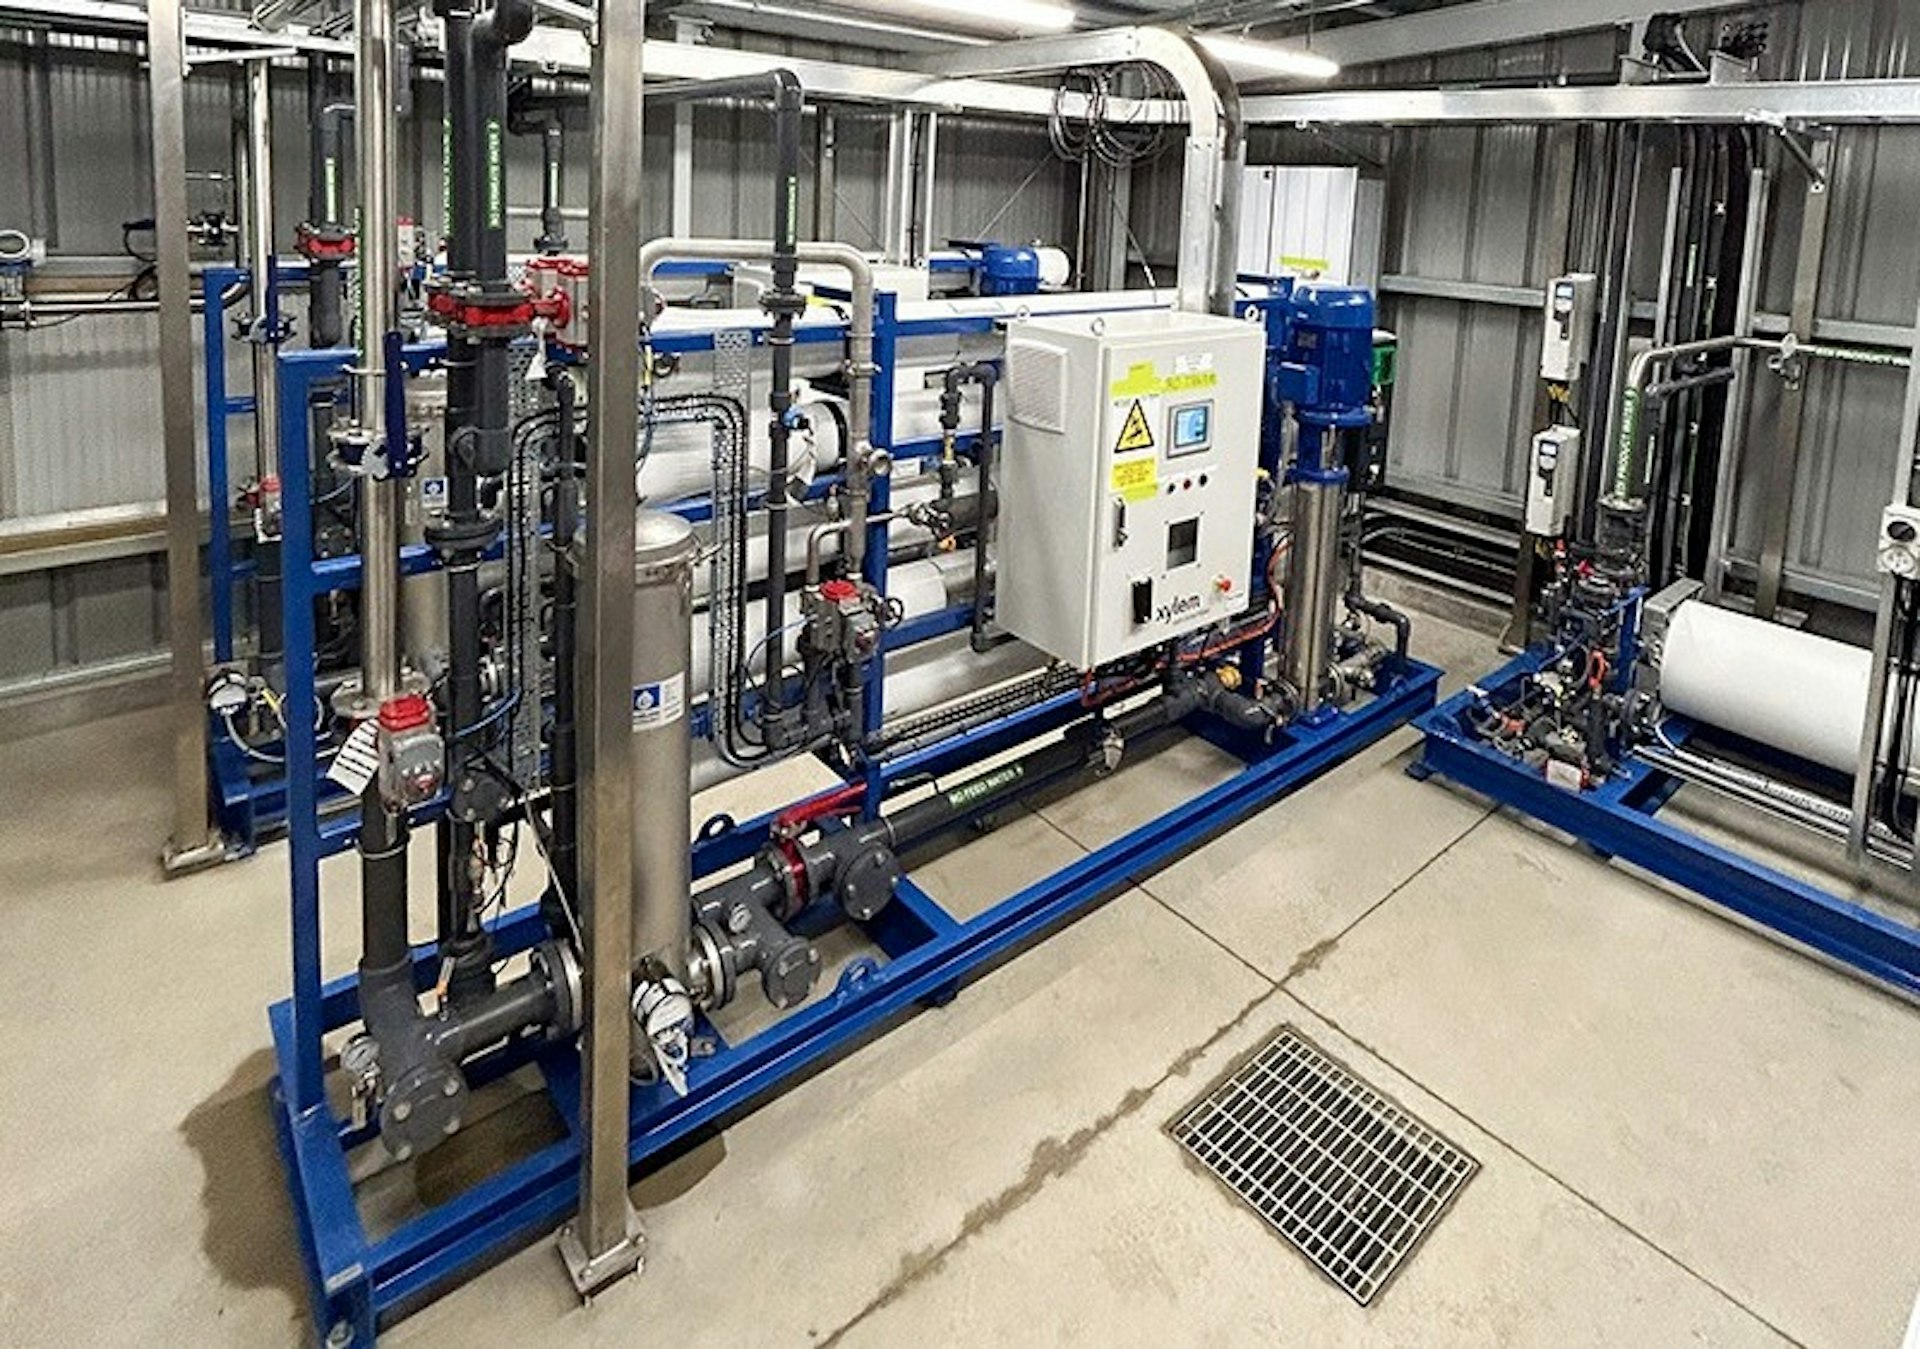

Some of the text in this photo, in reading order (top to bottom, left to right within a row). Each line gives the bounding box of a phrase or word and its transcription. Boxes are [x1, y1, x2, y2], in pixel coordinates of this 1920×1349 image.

[1622, 400, 1634, 433] WATER
[1617, 434, 1631, 479] PRODUCT
[1156, 595, 1201, 624] xylem
[964, 781, 987, 799] FEED
[986, 769, 1015, 787] WATER
